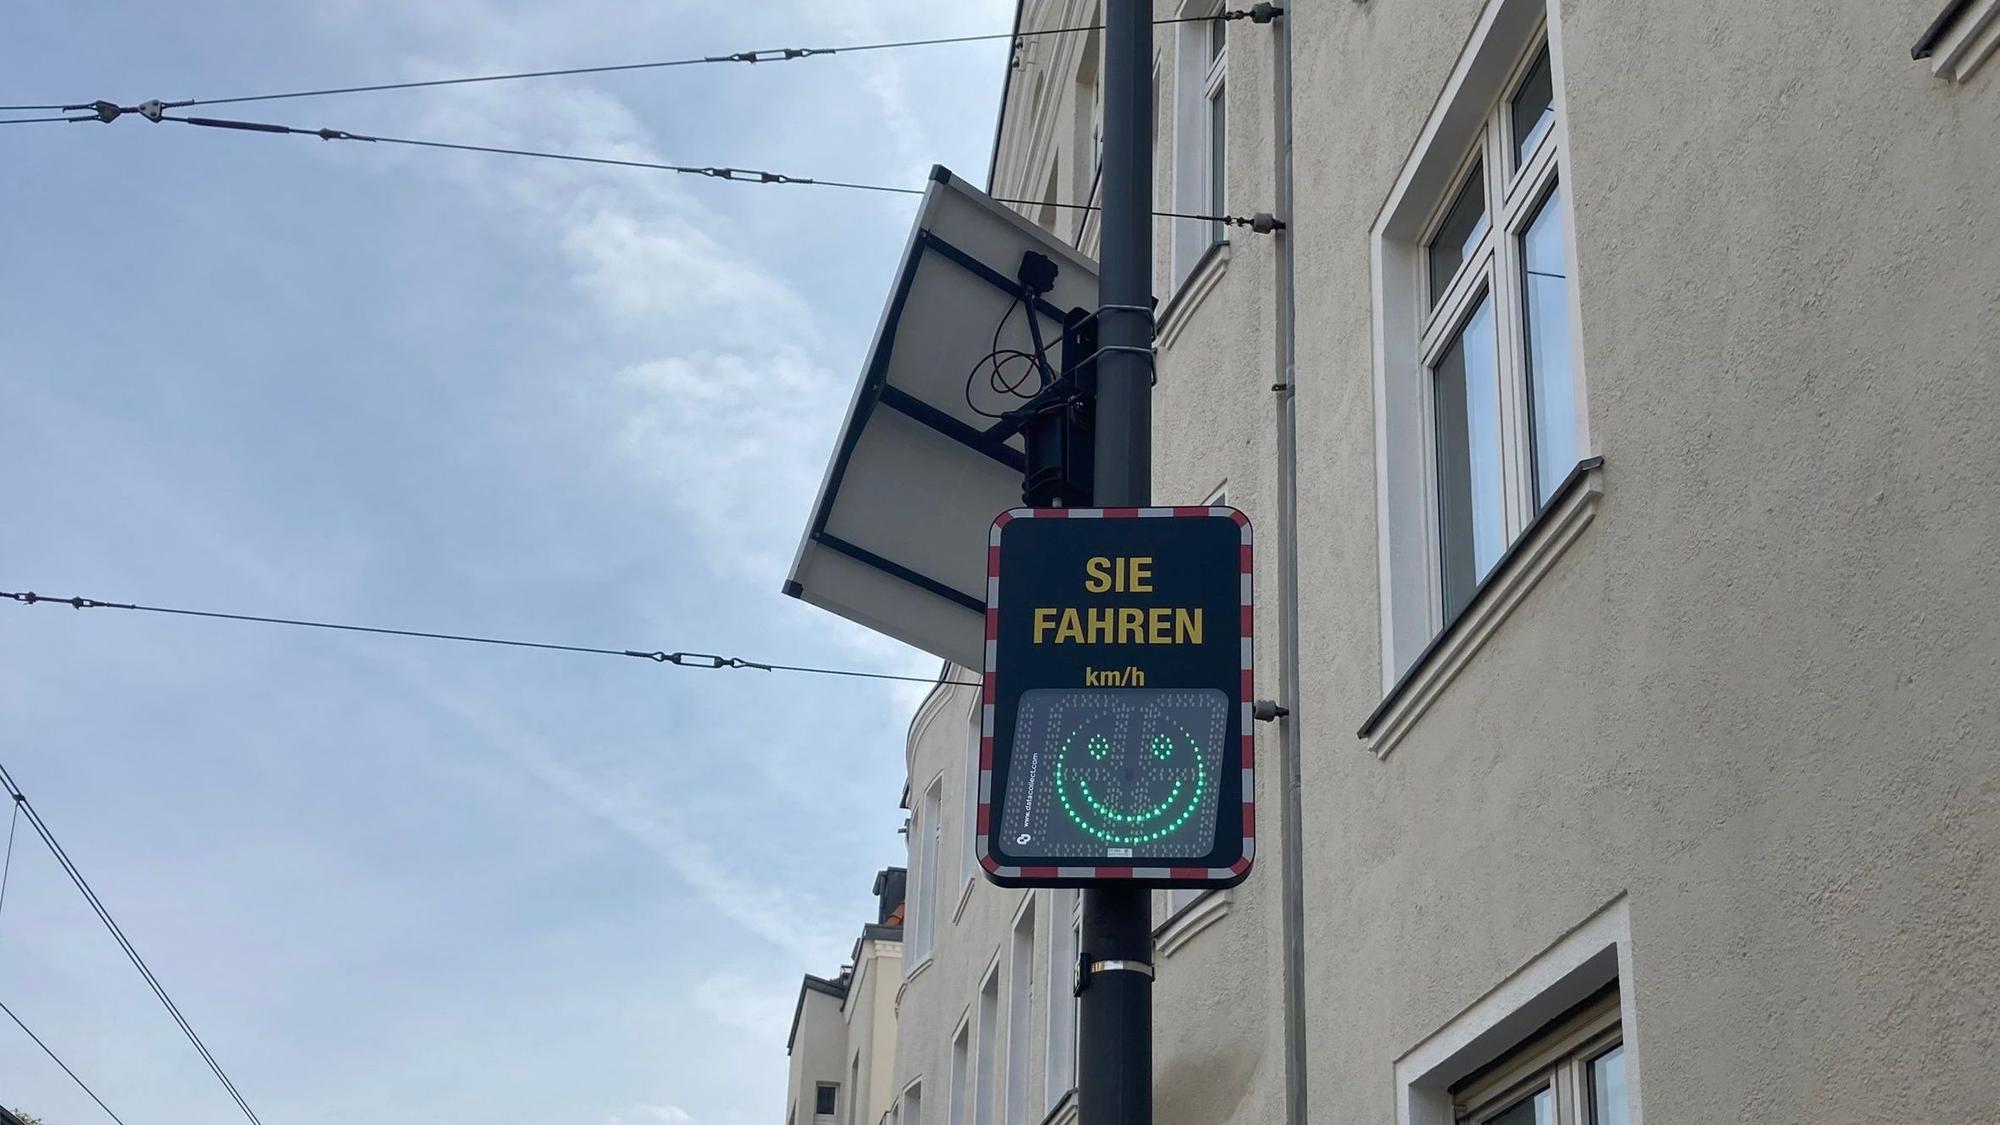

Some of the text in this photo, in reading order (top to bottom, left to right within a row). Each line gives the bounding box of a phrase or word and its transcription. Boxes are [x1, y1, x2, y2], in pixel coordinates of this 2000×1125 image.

[1085, 556, 1153, 593] SIE
[1033, 607, 1203, 644] FAHREN
[1085, 666, 1145, 687] km/h
[1024, 753, 1039, 828] www.datacollect.com
